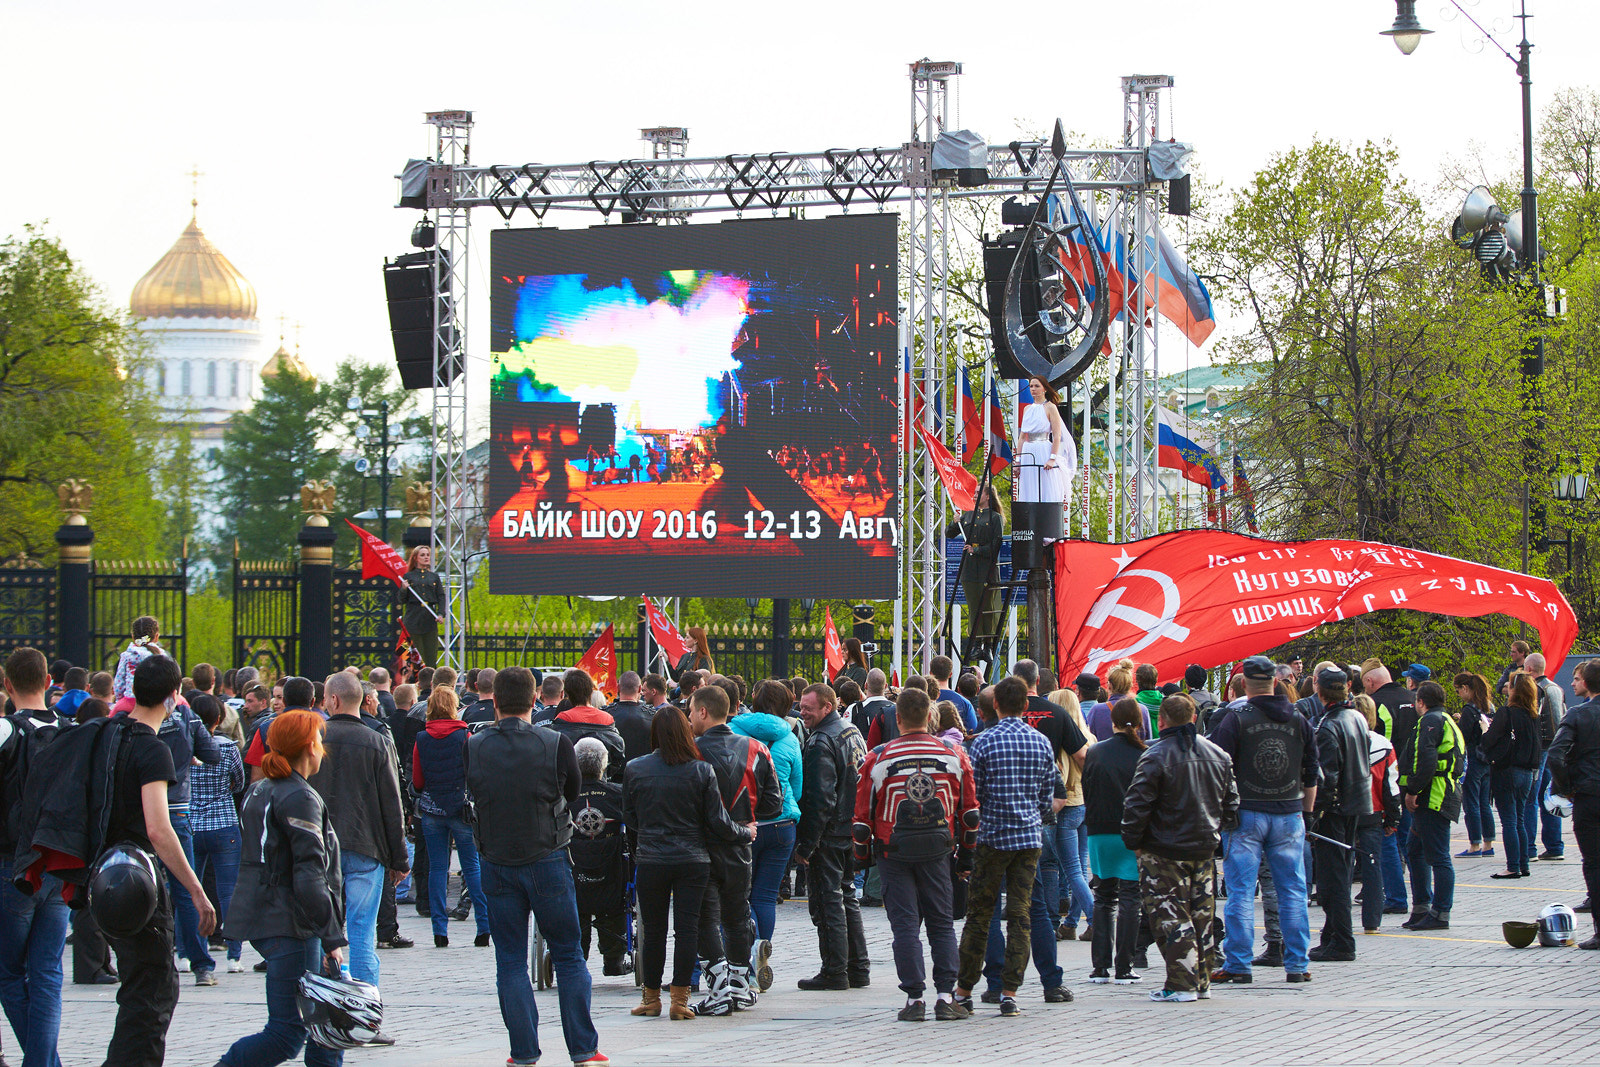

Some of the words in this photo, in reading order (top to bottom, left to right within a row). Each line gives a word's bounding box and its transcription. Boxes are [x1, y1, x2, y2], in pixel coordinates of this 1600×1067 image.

[924, 64, 948, 72] PROLYTE
[502, 502, 571, 539] БАЙК
[580, 510, 645, 539] ШОУ
[652, 510, 718, 539] 2016
[743, 510, 822, 539] 12-13
[838, 510, 898, 547] Авгу
